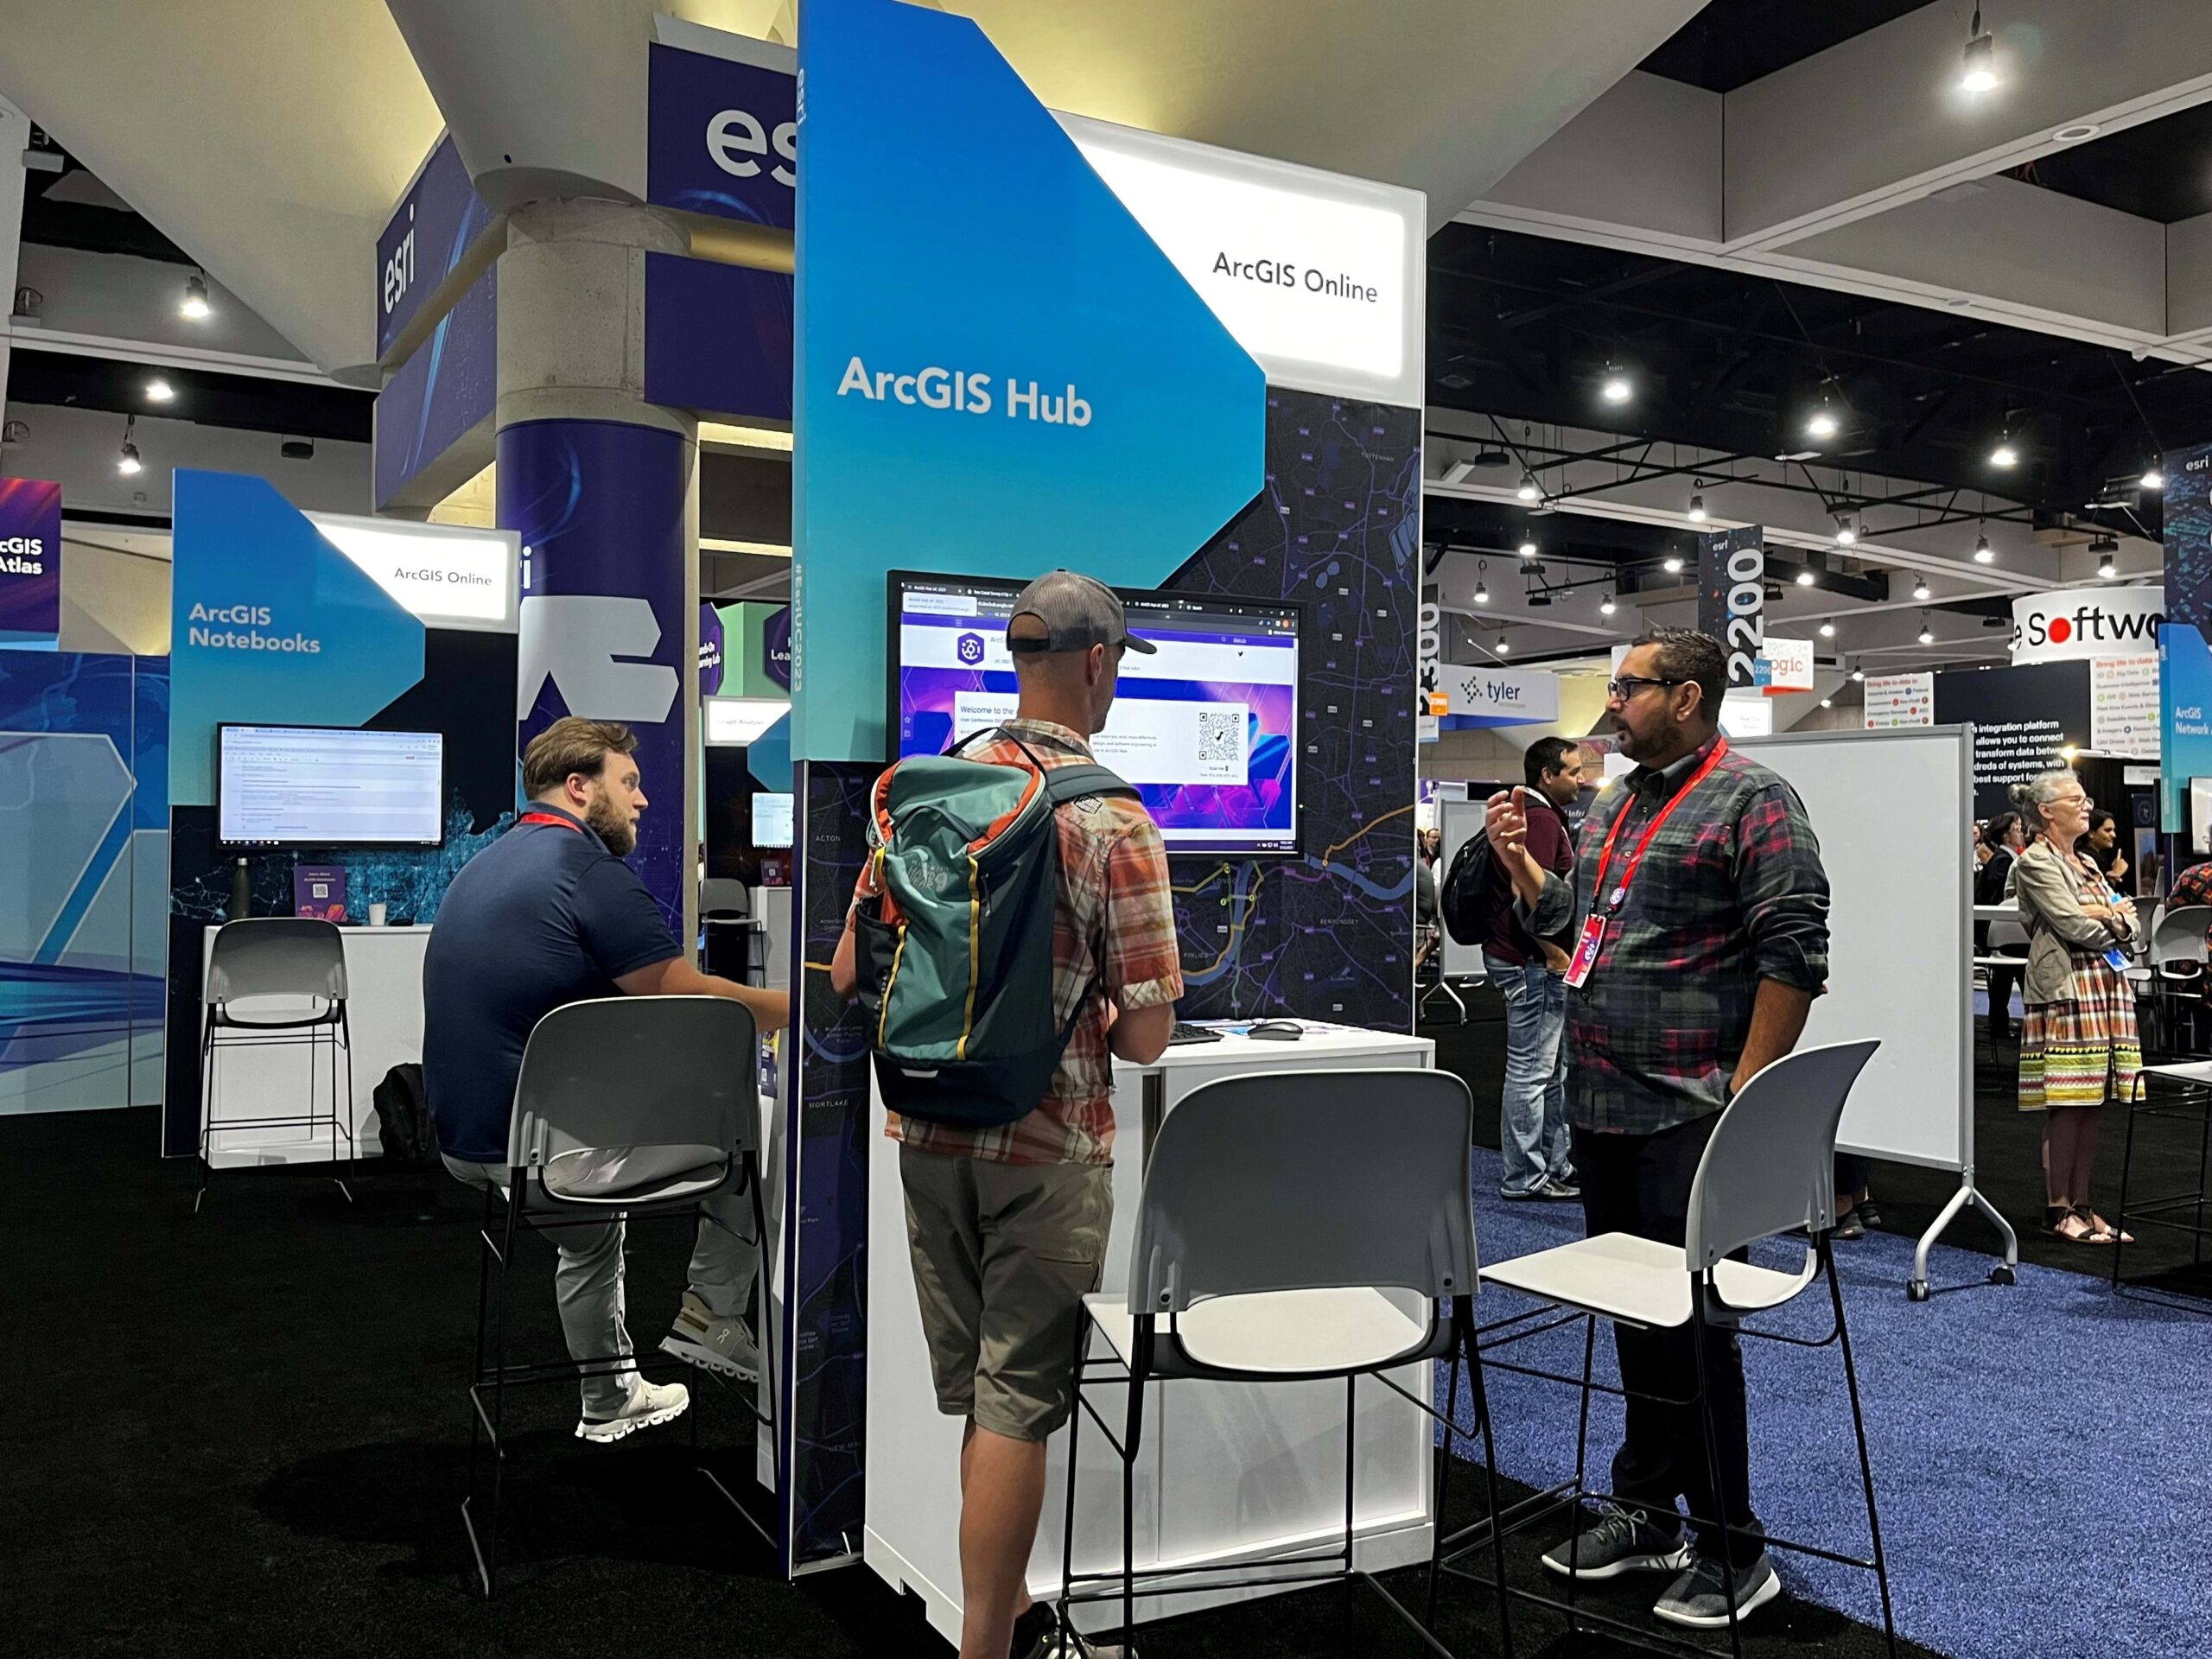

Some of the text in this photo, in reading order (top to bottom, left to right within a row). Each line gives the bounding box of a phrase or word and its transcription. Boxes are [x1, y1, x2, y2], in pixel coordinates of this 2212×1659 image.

[385, 203, 414, 314] esri
[1212, 251, 1377, 302] ArcGIS Online
[836, 356, 1092, 427] ArcGIS Hub
[2185, 454, 2209, 471] esri
[1712, 539, 1728, 551] esri
[395, 568, 493, 586] ArcGIS Online
[188, 603, 271, 626] ArcGIS
[1727, 548, 1764, 683] 2200
[188, 627, 321, 654] Notebooks
[1754, 664, 1771, 676] 2200
[1487, 681, 1521, 702] tyler
[960, 705, 992, 714] Welcome
[2175, 707, 2201, 719] ArcGIS
[1979, 722, 2022, 734] integration
[2024, 720, 2059, 732] platform
[2175, 721, 2209, 735] Network
[1975, 733, 2064, 746] allows you to connect
[1975, 748, 2014, 758] transform
[2016, 747, 2035, 756] data
[1999, 760, 2006, 770] of
[2008, 760, 2045, 771] systems,
[2046, 759, 2064, 767] with
[1974, 775, 1991, 784] best
[1993, 772, 2024, 784] support
[809, 1098, 849, 1109] MORTLAKE
